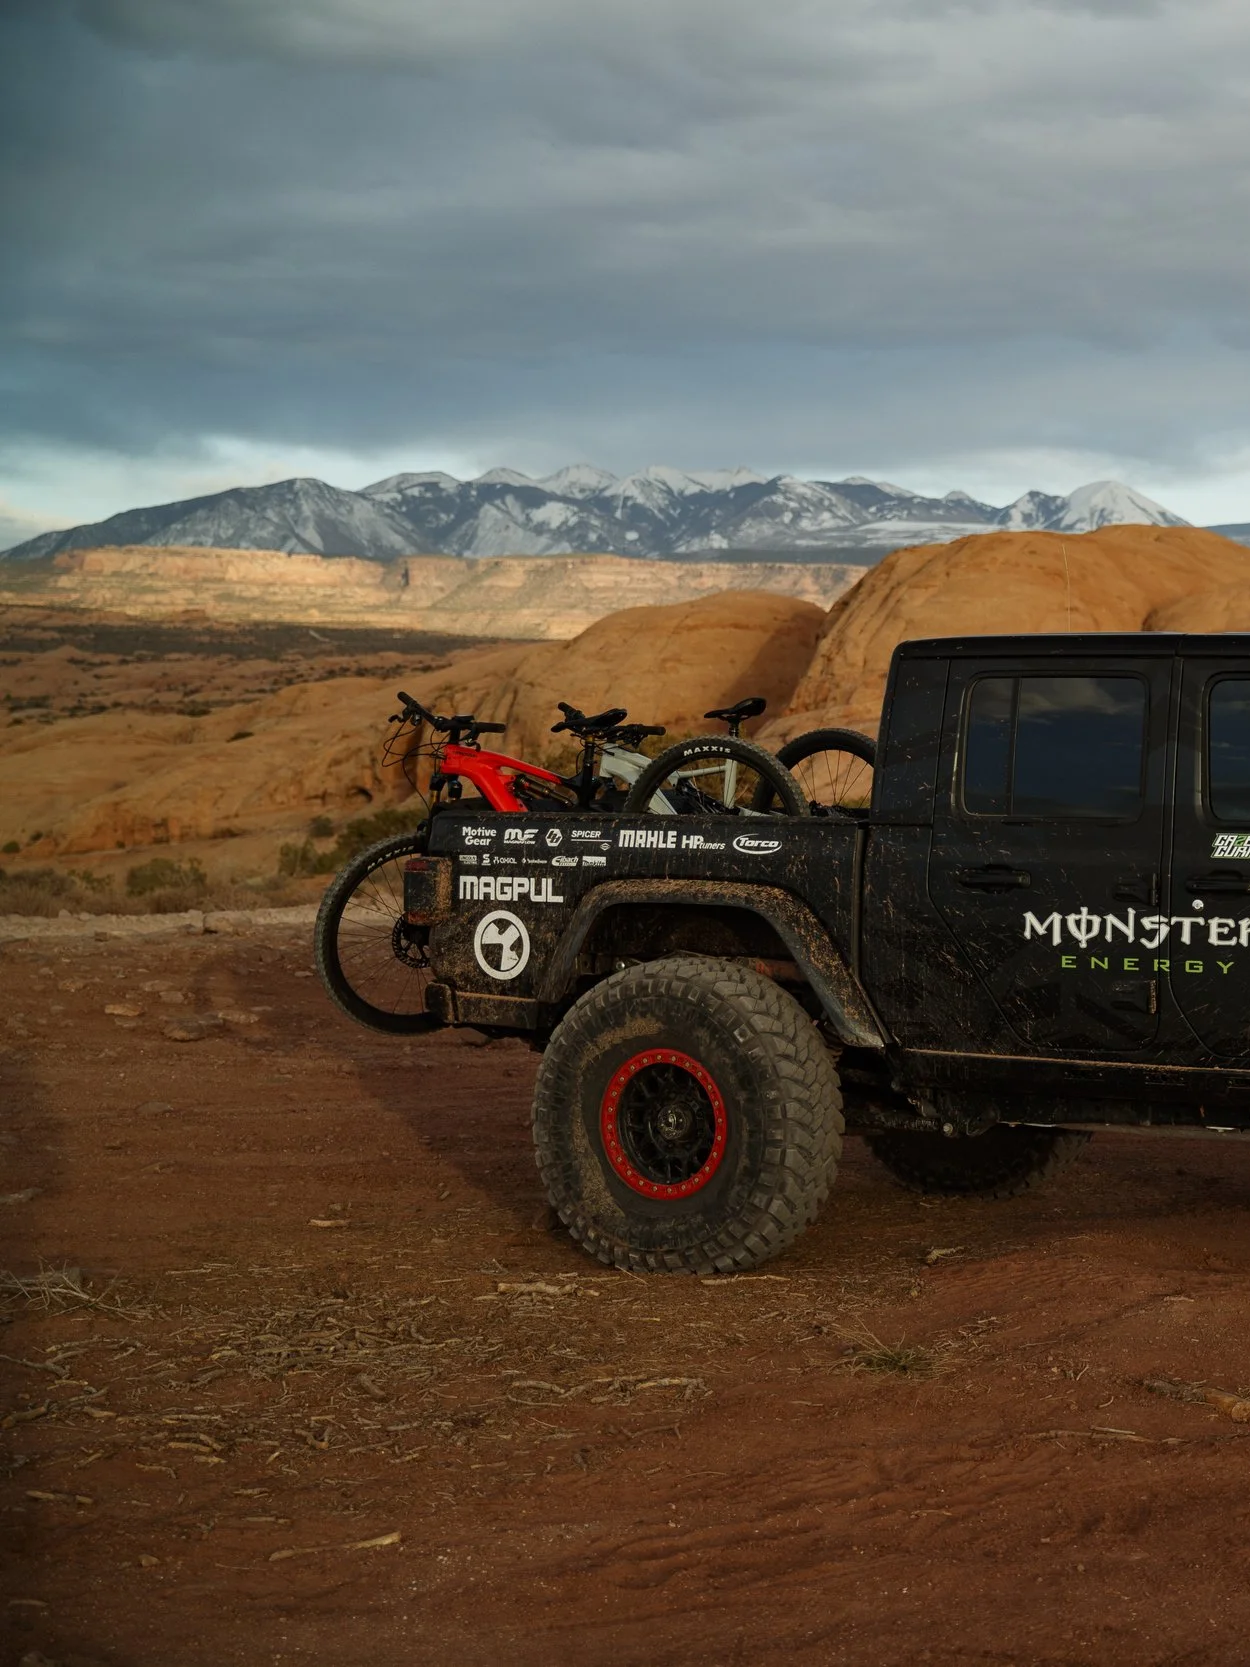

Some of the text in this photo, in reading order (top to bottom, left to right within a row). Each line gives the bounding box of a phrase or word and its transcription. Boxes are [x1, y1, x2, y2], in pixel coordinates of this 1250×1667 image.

[683, 746, 731, 757] MAXXIS
[461, 826, 497, 837] Motive
[571, 830, 602, 839] SPICER
[464, 836, 492, 846] Gear
[618, 829, 677, 849] MAHLE
[738, 837, 780, 848] Torco
[459, 875, 564, 903] MAGPUL
[1061, 955, 1235, 975] ENERGY
